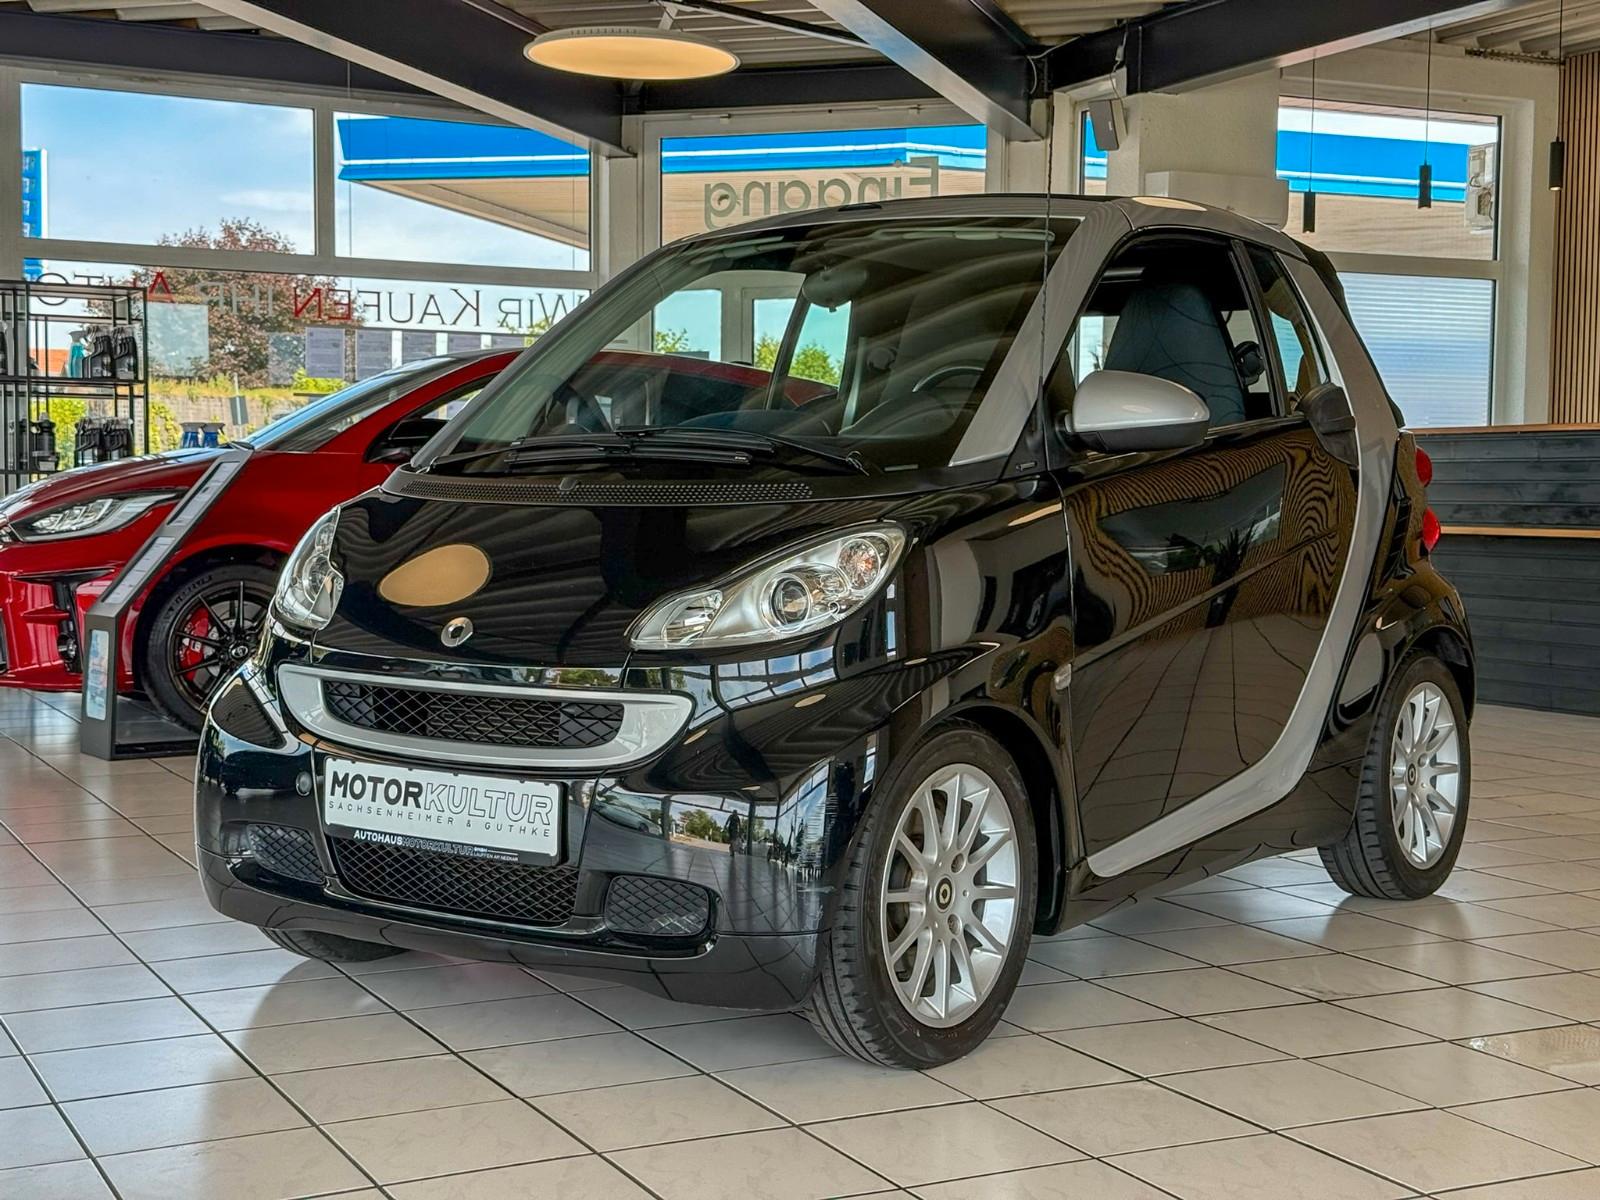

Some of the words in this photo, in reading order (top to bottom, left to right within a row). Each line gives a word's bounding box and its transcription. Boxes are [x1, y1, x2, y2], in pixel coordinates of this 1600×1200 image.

[328, 800, 455, 825] SACHSENHEIMER
[466, 819, 472, 828] &
[485, 822, 550, 838] GUTHKE
